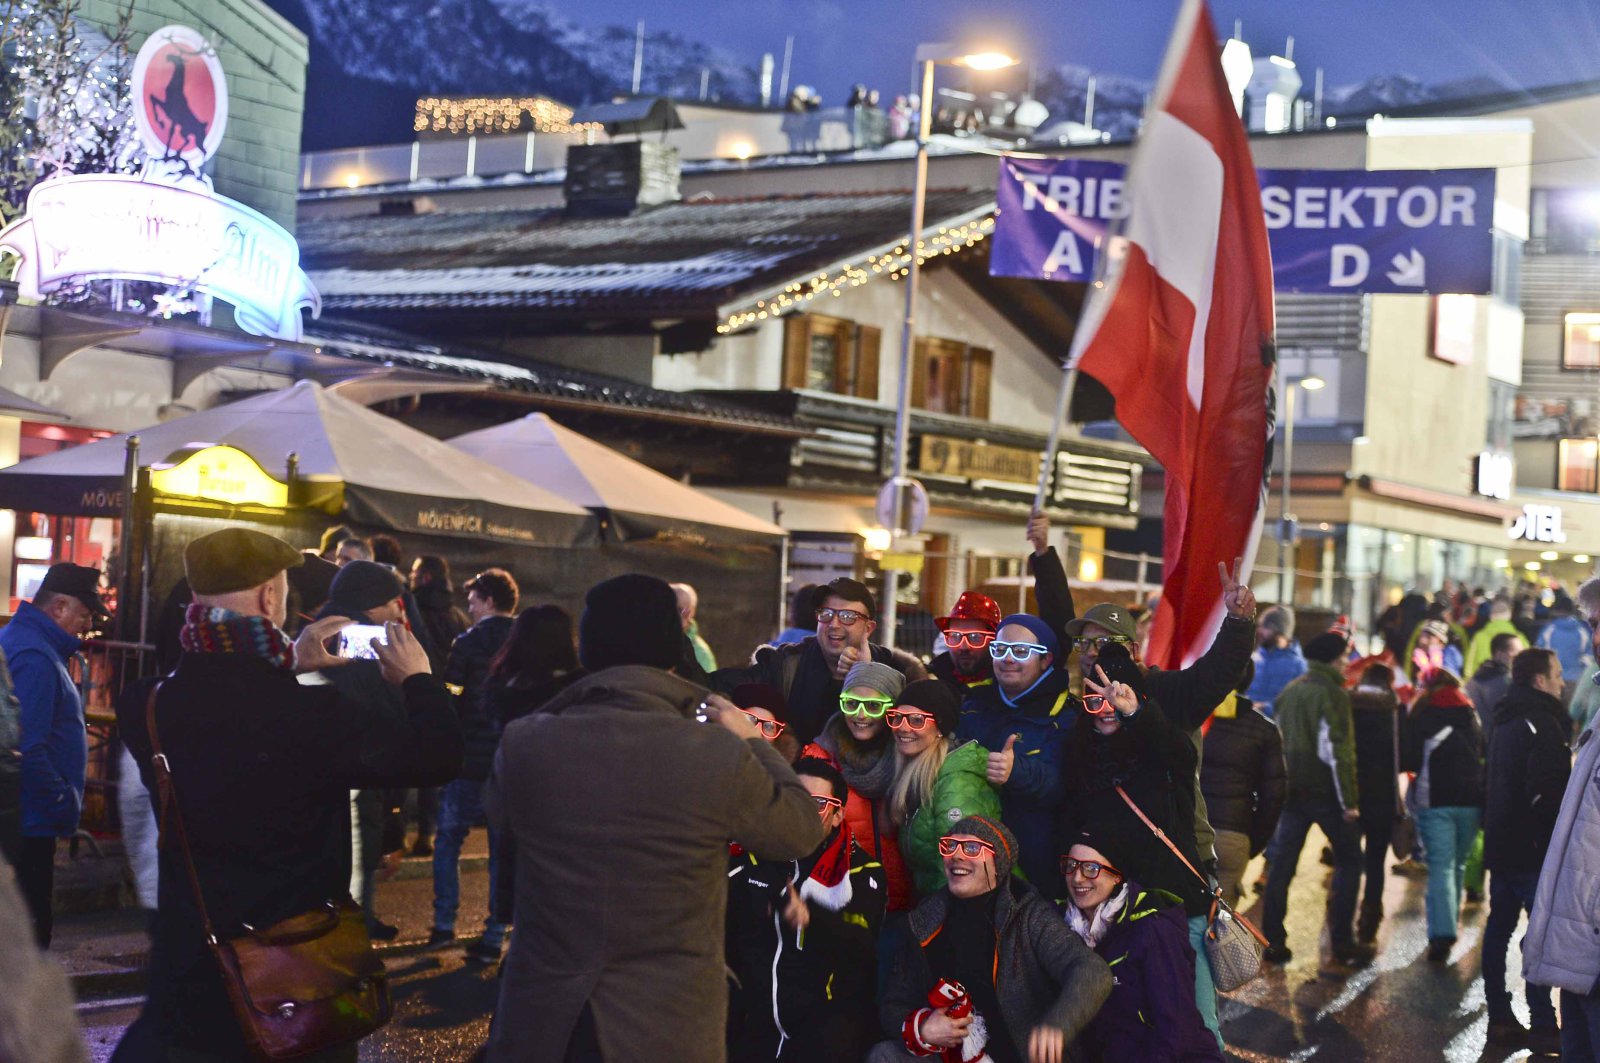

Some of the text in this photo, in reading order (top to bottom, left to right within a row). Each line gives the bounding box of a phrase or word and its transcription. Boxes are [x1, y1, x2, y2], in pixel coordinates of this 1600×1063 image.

[1262, 185, 1477, 229] SEKTOR
[1042, 229, 1370, 287] A D
